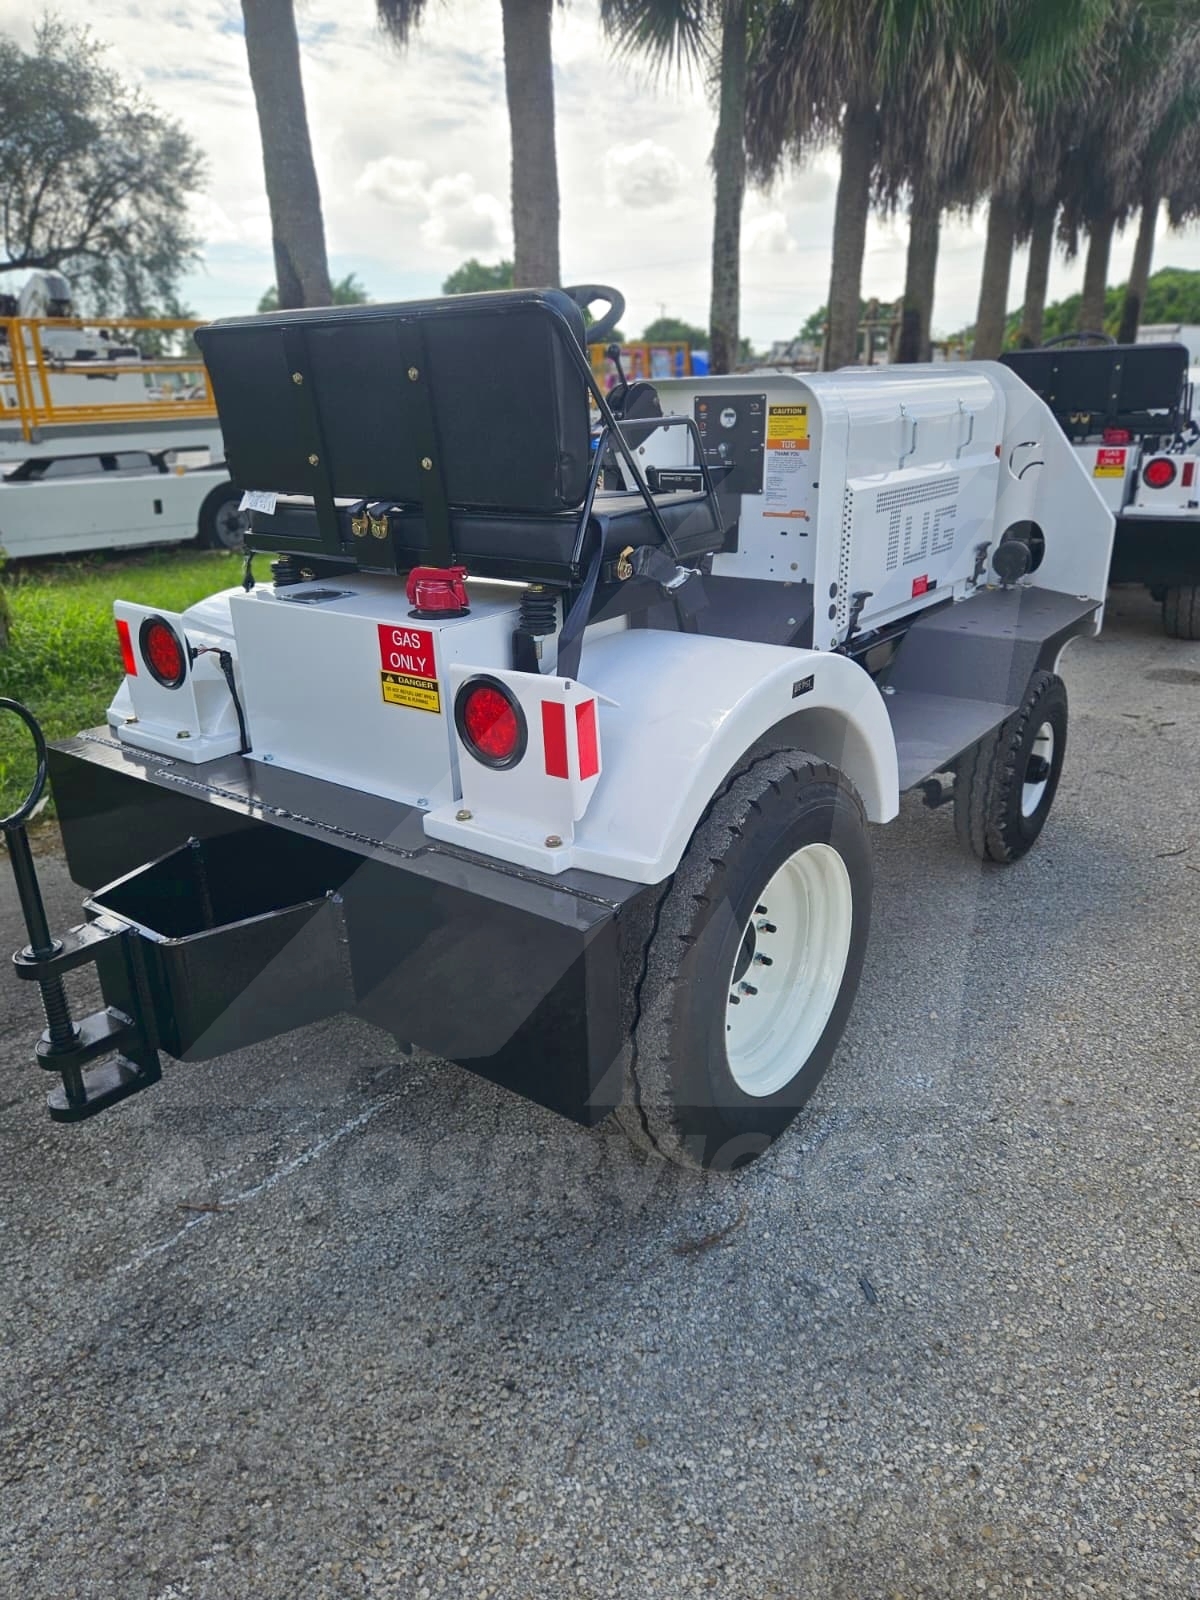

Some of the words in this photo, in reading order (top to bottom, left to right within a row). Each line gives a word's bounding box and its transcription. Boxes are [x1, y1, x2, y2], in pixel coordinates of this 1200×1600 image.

[781, 440, 796, 449] TUG
[392, 630, 420, 648] GAS
[390, 652, 426, 672] ONLY
[398, 677, 433, 689] DANGER
